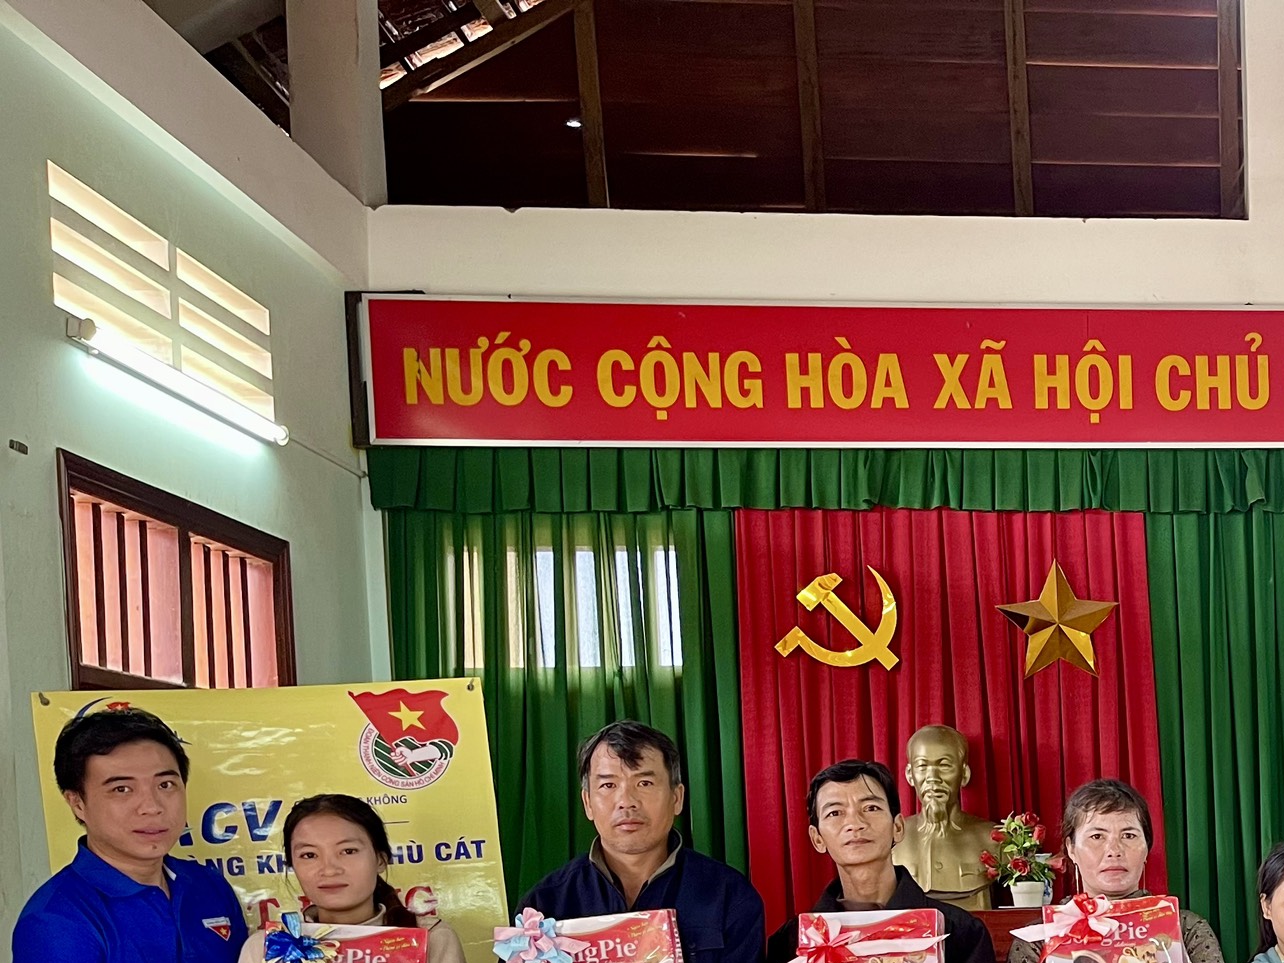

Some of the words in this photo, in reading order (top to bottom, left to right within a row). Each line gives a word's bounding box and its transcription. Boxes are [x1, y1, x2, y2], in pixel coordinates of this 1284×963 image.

[403, 331, 573, 408] NƯỚC
[597, 335, 764, 420] CỘNG
[785, 336, 909, 410] HÒA
[933, 339, 1013, 409] XÃ
[1034, 339, 1133, 424] HỘI
[1155, 332, 1270, 412] CHỦ
[366, 794, 408, 806] KHÔNG
[179, 799, 283, 845] CV
[387, 840, 424, 865] HÙ
[434, 835, 486, 862] CÁT
